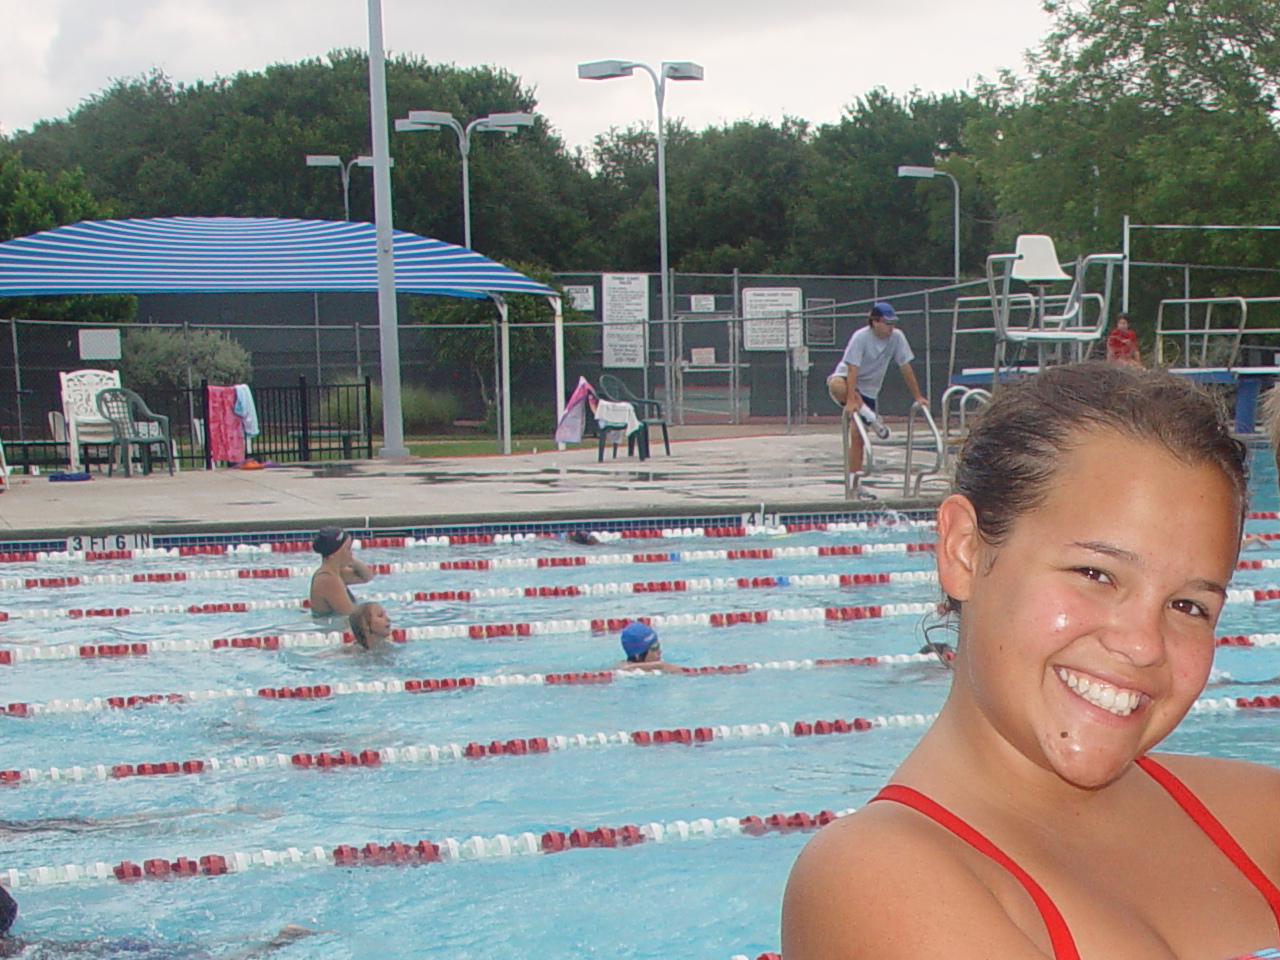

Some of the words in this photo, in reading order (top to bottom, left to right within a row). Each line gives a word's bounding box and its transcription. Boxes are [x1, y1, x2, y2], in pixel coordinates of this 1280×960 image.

[746, 512, 756, 526] 4
[72, 536, 83, 551] 3
[90, 535, 108, 550] FT
[115, 535, 126, 550] 6
[134, 533, 150, 549] IN
